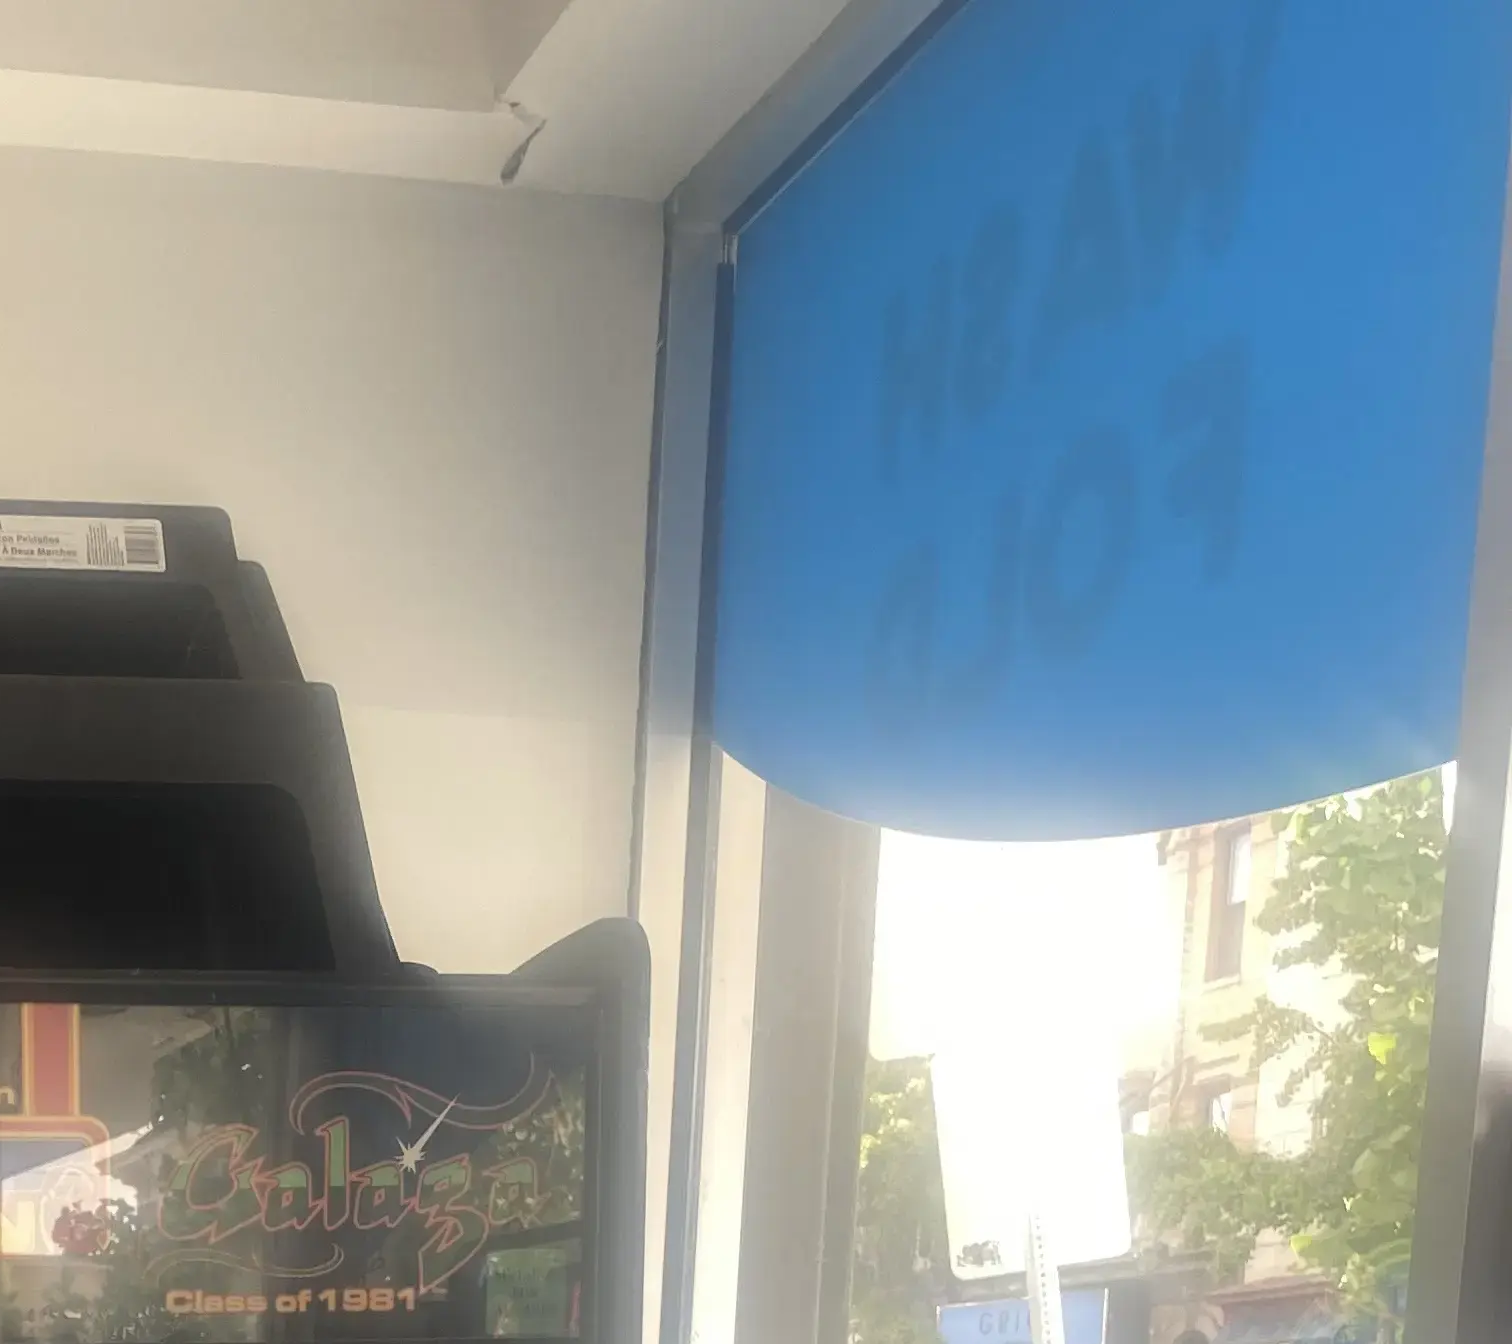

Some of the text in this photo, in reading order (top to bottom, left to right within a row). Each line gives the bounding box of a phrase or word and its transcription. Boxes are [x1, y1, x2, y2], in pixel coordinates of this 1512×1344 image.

[157, 1116, 552, 1294] Galaga
[165, 1286, 418, 1315] Class of 1981
